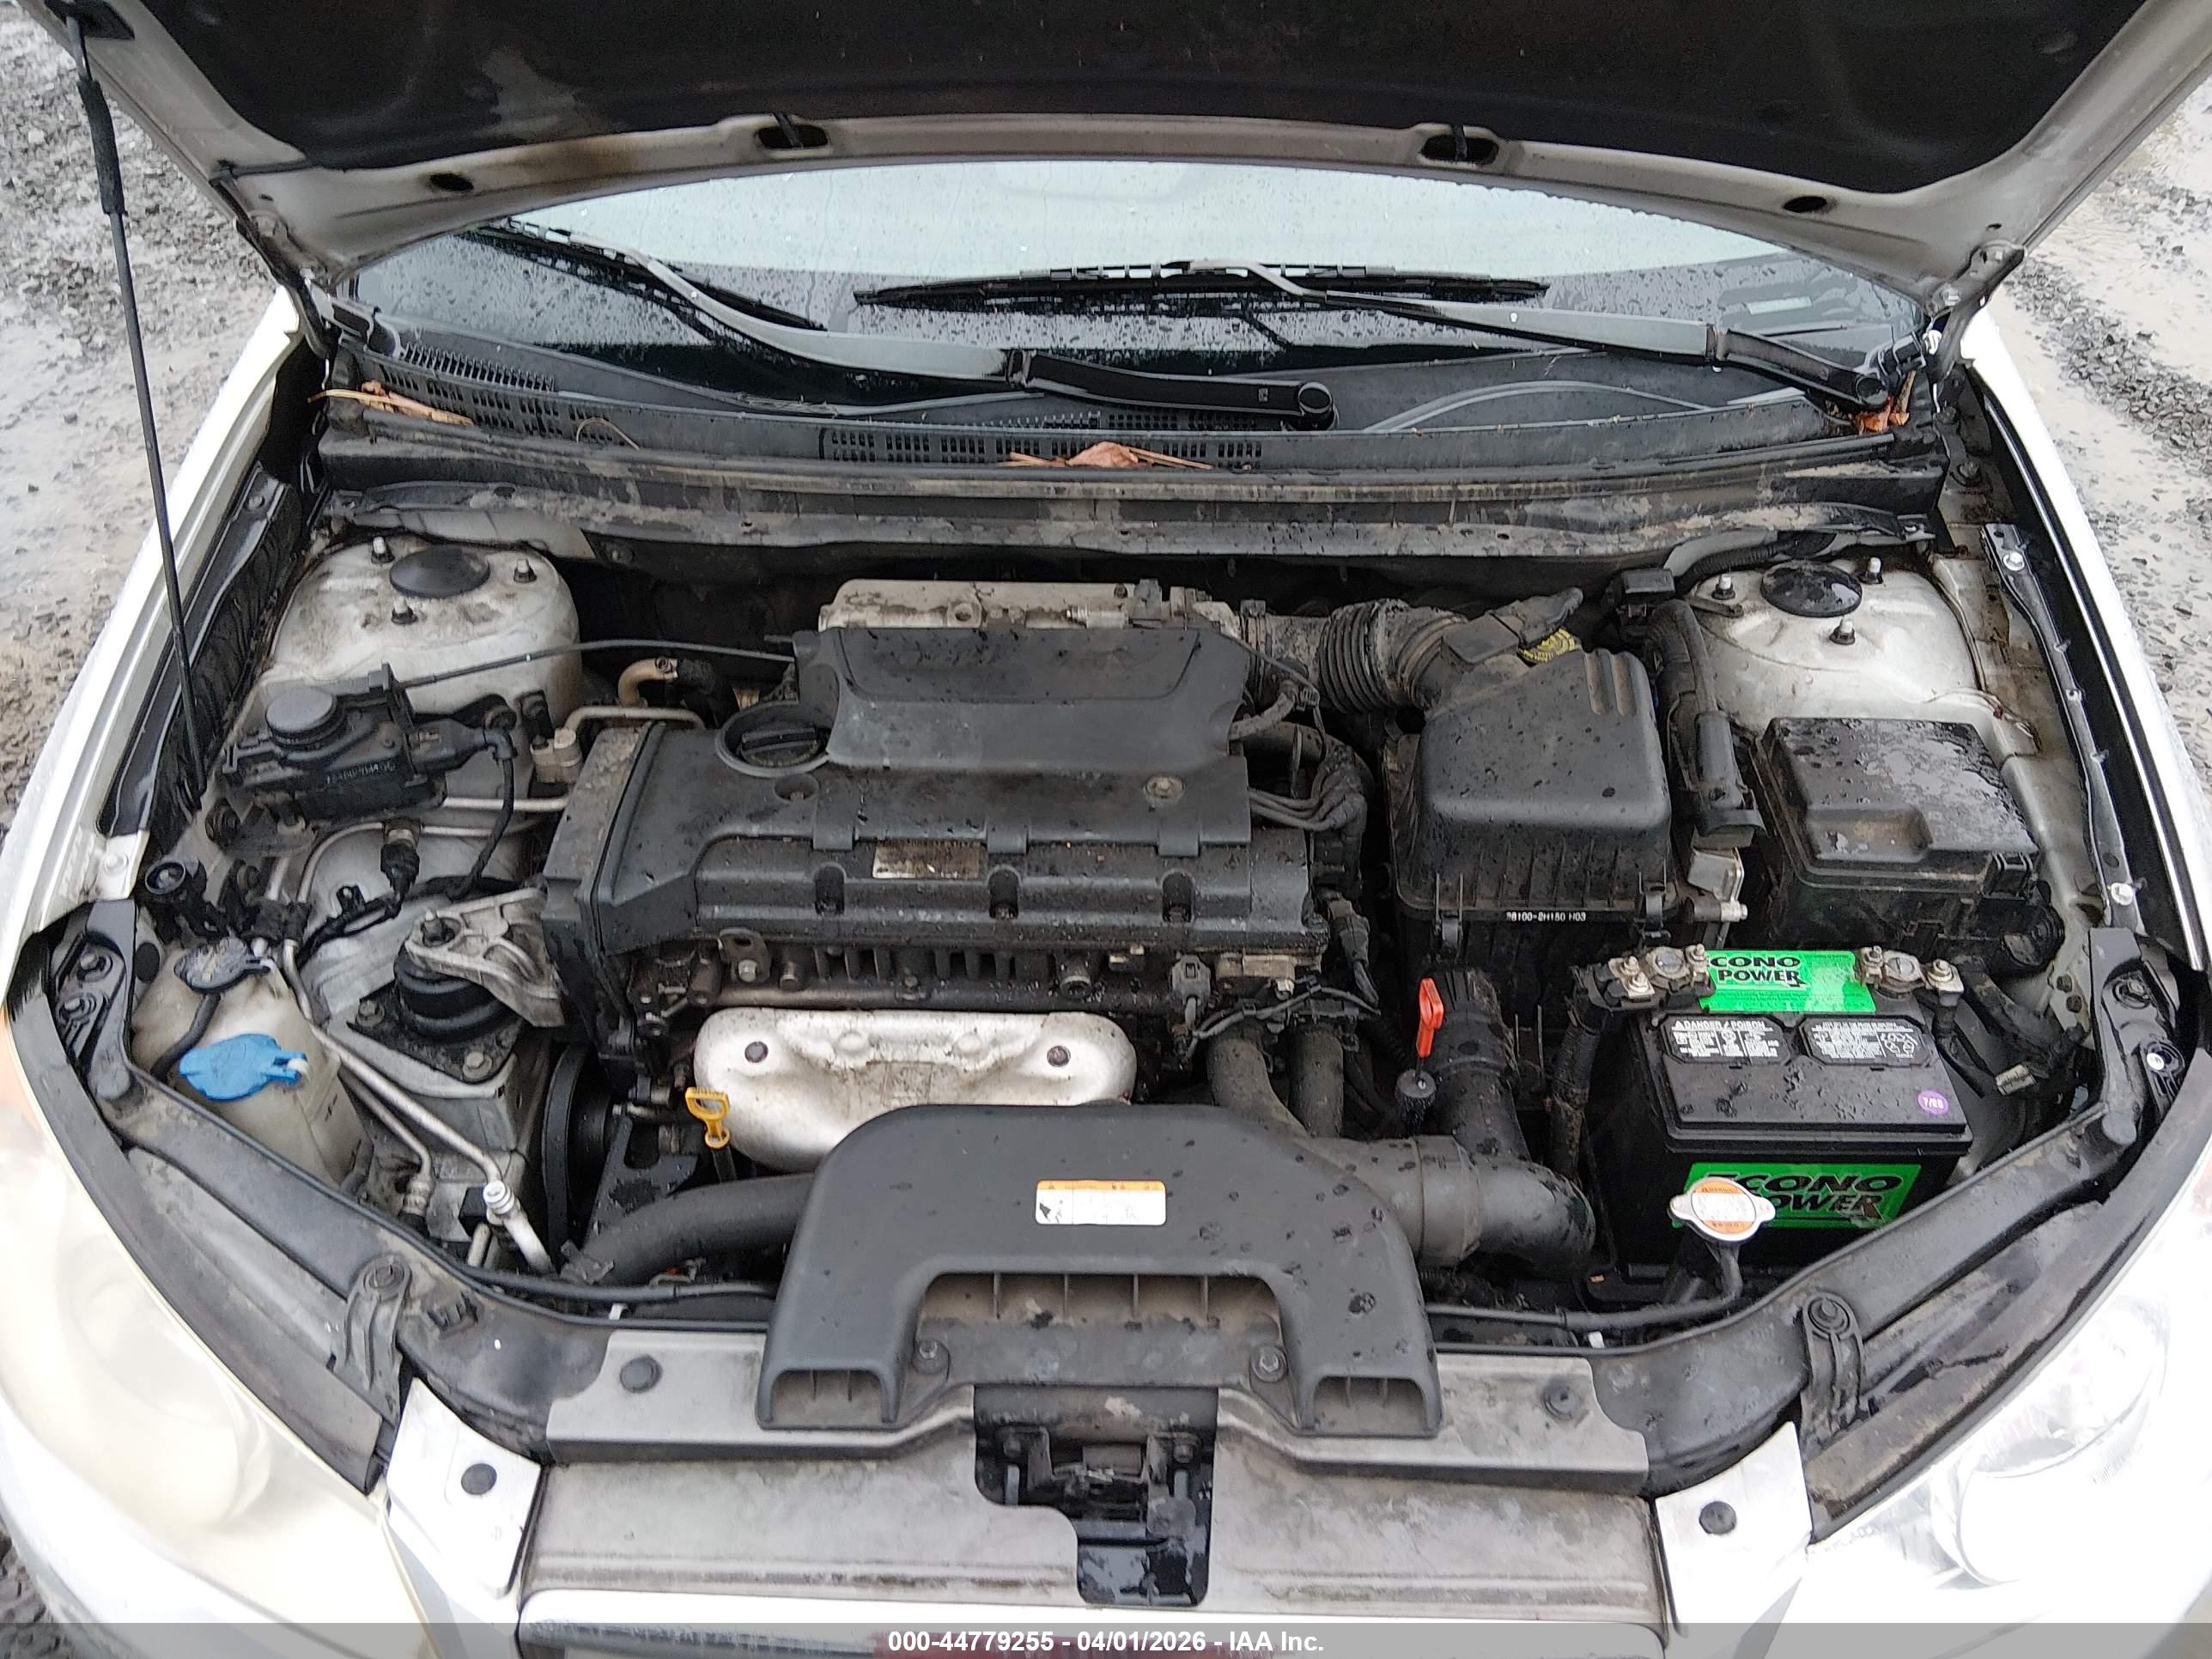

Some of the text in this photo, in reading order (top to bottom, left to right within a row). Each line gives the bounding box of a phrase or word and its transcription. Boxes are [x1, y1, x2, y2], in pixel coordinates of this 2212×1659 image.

[1707, 956, 1801, 968] CONO
[1717, 969, 1808, 987] POWER
[1765, 1194, 1885, 1222] OWER
